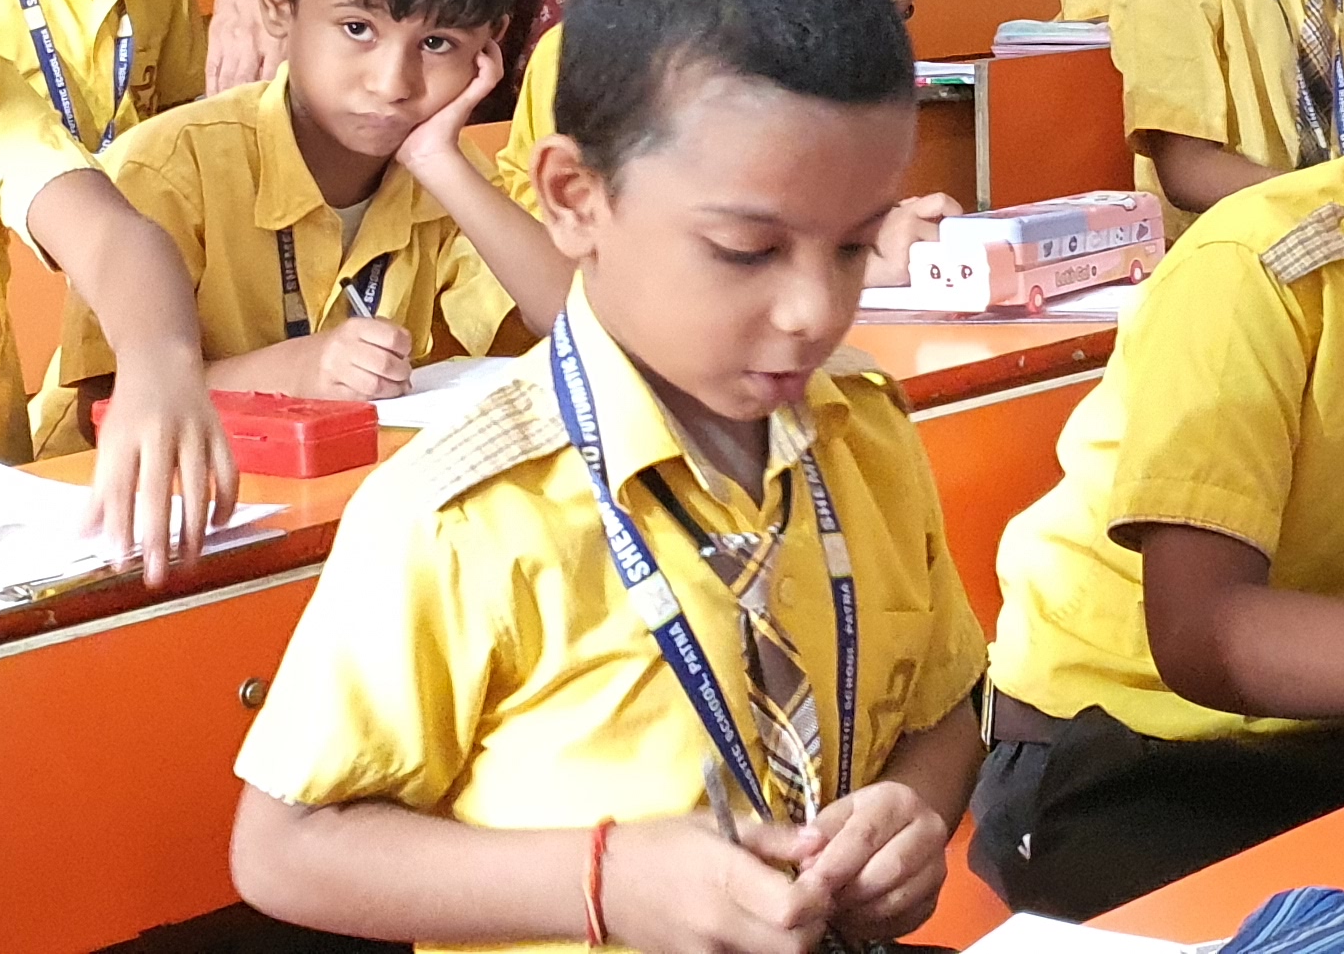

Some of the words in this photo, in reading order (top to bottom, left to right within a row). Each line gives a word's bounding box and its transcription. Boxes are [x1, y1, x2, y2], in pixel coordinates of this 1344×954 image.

[40, 29, 54, 53] PATNA
[561, 357, 599, 442] FUTURISTIC
[841, 582, 854, 636] PATNA
[668, 621, 702, 675] PATNA
[698, 672, 734, 743] SCHOOL,
